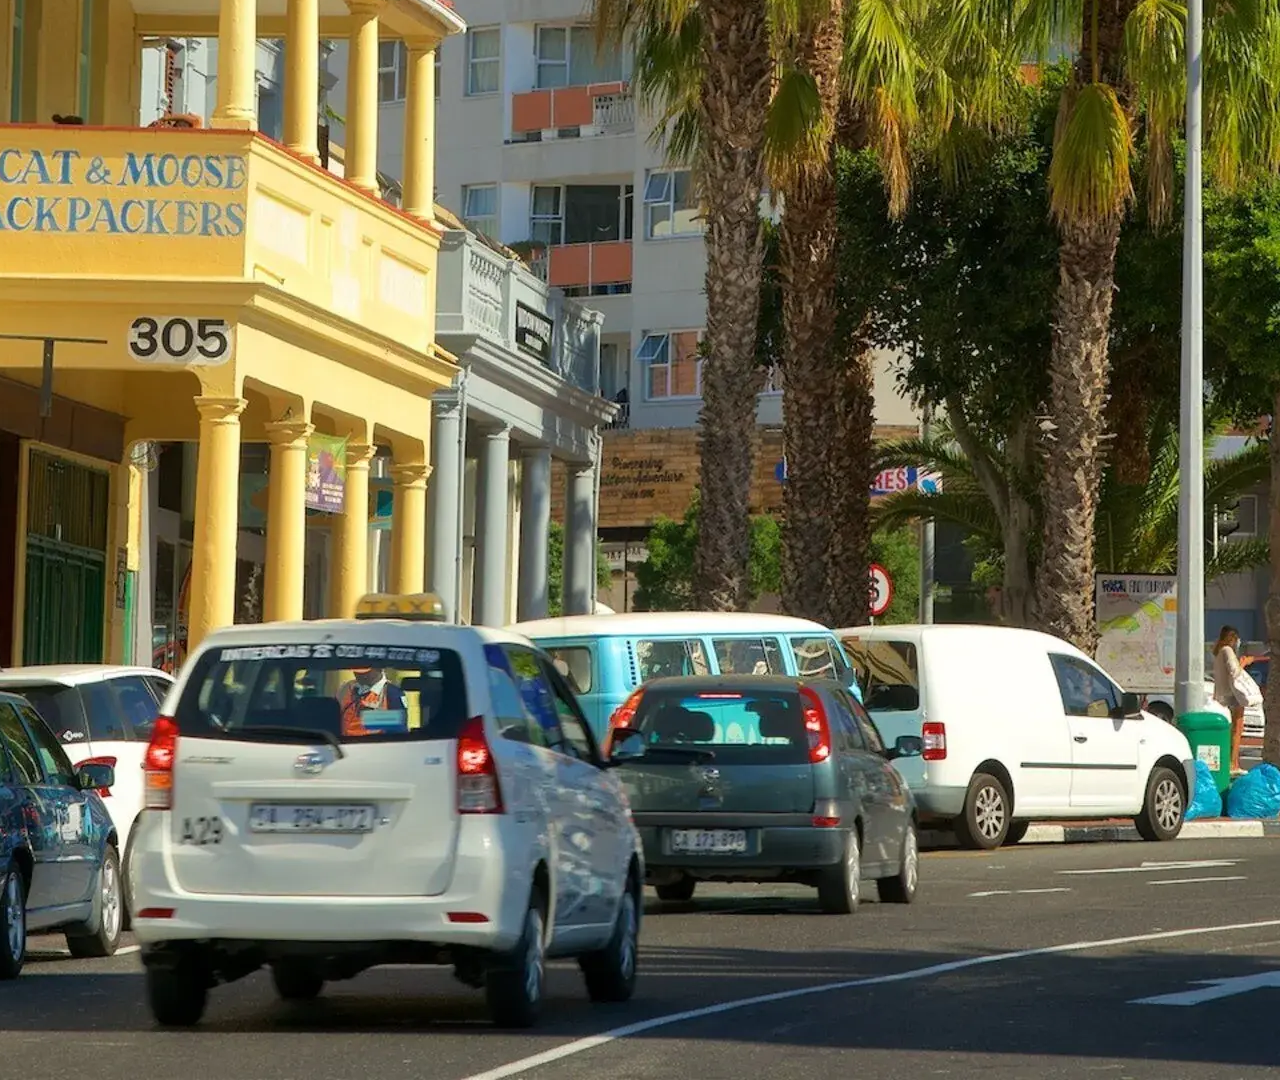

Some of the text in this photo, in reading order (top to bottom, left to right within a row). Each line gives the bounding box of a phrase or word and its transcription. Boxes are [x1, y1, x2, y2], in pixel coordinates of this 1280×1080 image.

[85, 156, 113, 185] &
[117, 152, 248, 190] MOOSE
[130, 317, 227, 358] 305
[874, 469, 907, 490] RES
[366, 600, 436, 614] TAX
